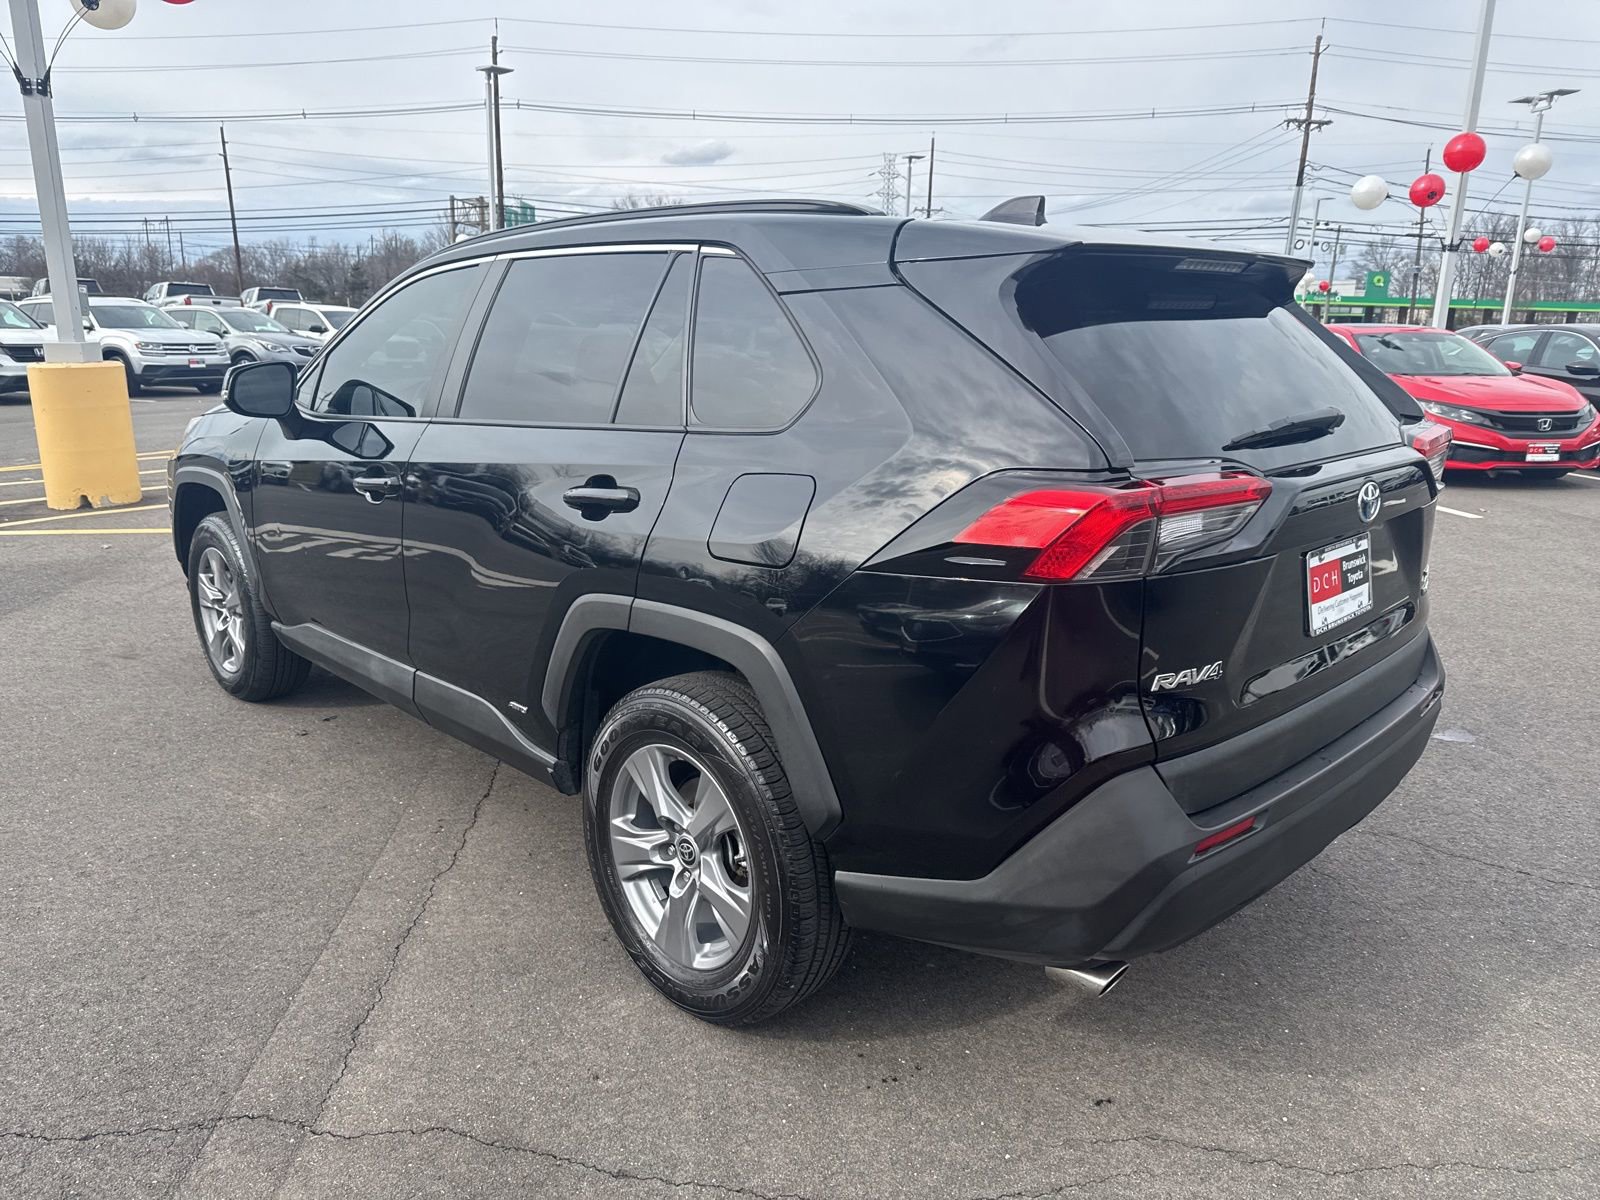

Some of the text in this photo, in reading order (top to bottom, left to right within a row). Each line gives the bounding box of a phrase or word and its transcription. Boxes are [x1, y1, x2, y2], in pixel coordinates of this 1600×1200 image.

[1343, 553, 1366, 571] Brunswick
[1313, 569, 1338, 593] DCH
[1347, 570, 1363, 584] Toyota
[1150, 660, 1223, 692] RAV4
